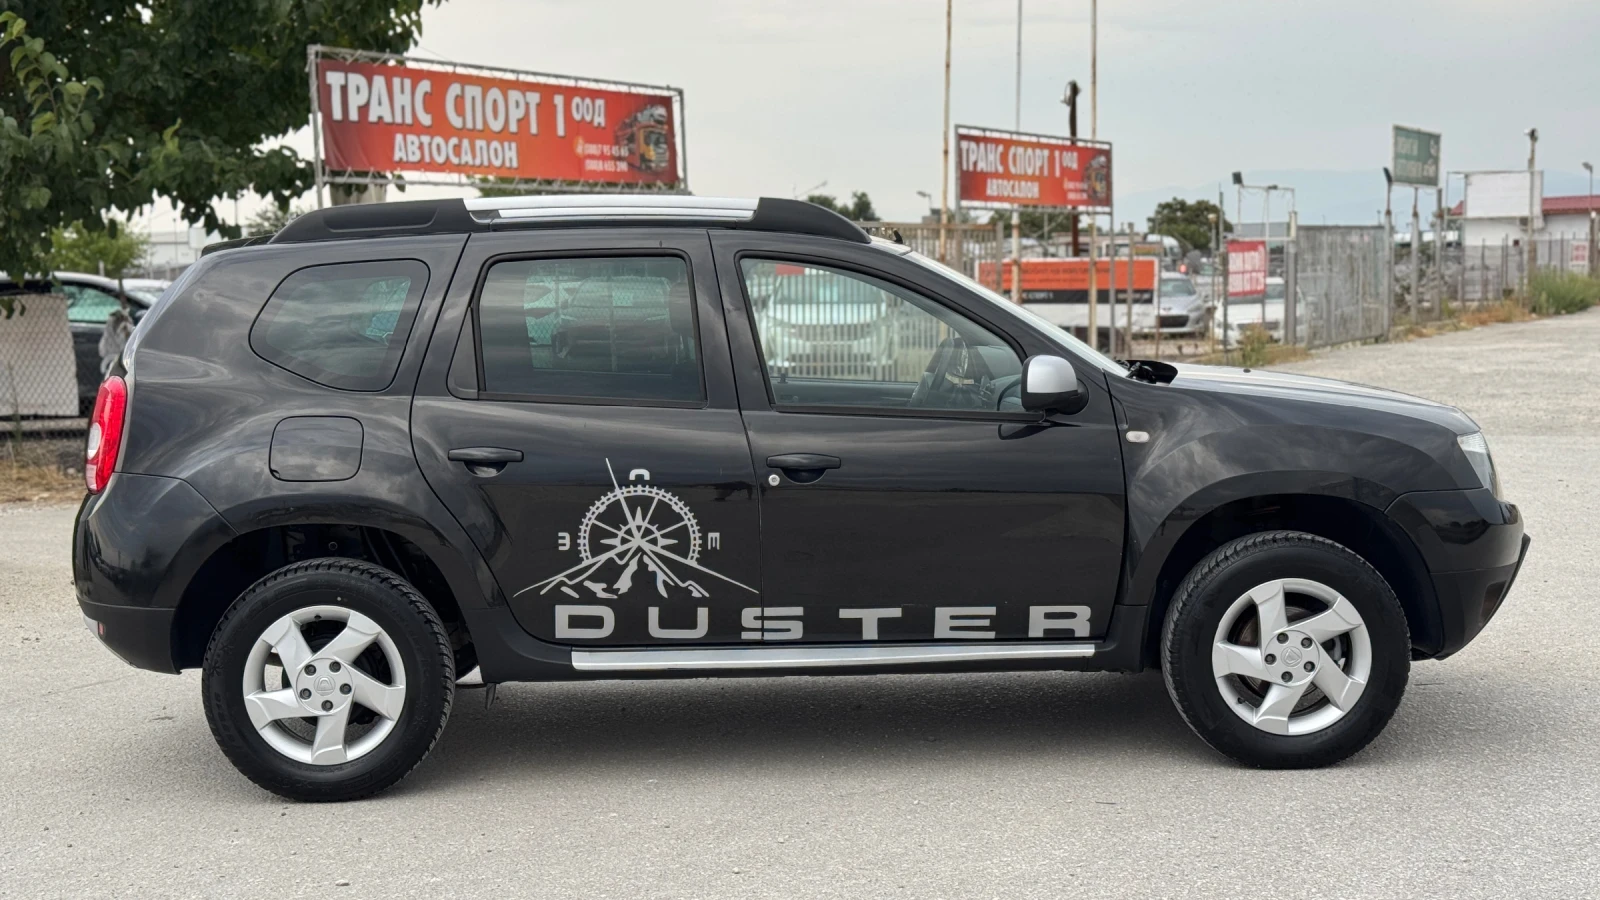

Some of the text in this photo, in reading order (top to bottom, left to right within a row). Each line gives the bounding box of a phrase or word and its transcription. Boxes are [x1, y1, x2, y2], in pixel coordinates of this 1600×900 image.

[326, 70, 606, 137] ТРАНС СПОРТ 1 ООД
[393, 133, 518, 168] АВТОСАЛОН
[960, 140, 1004, 173] ТРАНС
[1008, 145, 1049, 177] СПОРТ
[1054, 150, 1061, 177] 1
[986, 178, 1039, 199] АВТОСАЛОН
[554, 604, 1091, 640] DUSTER
